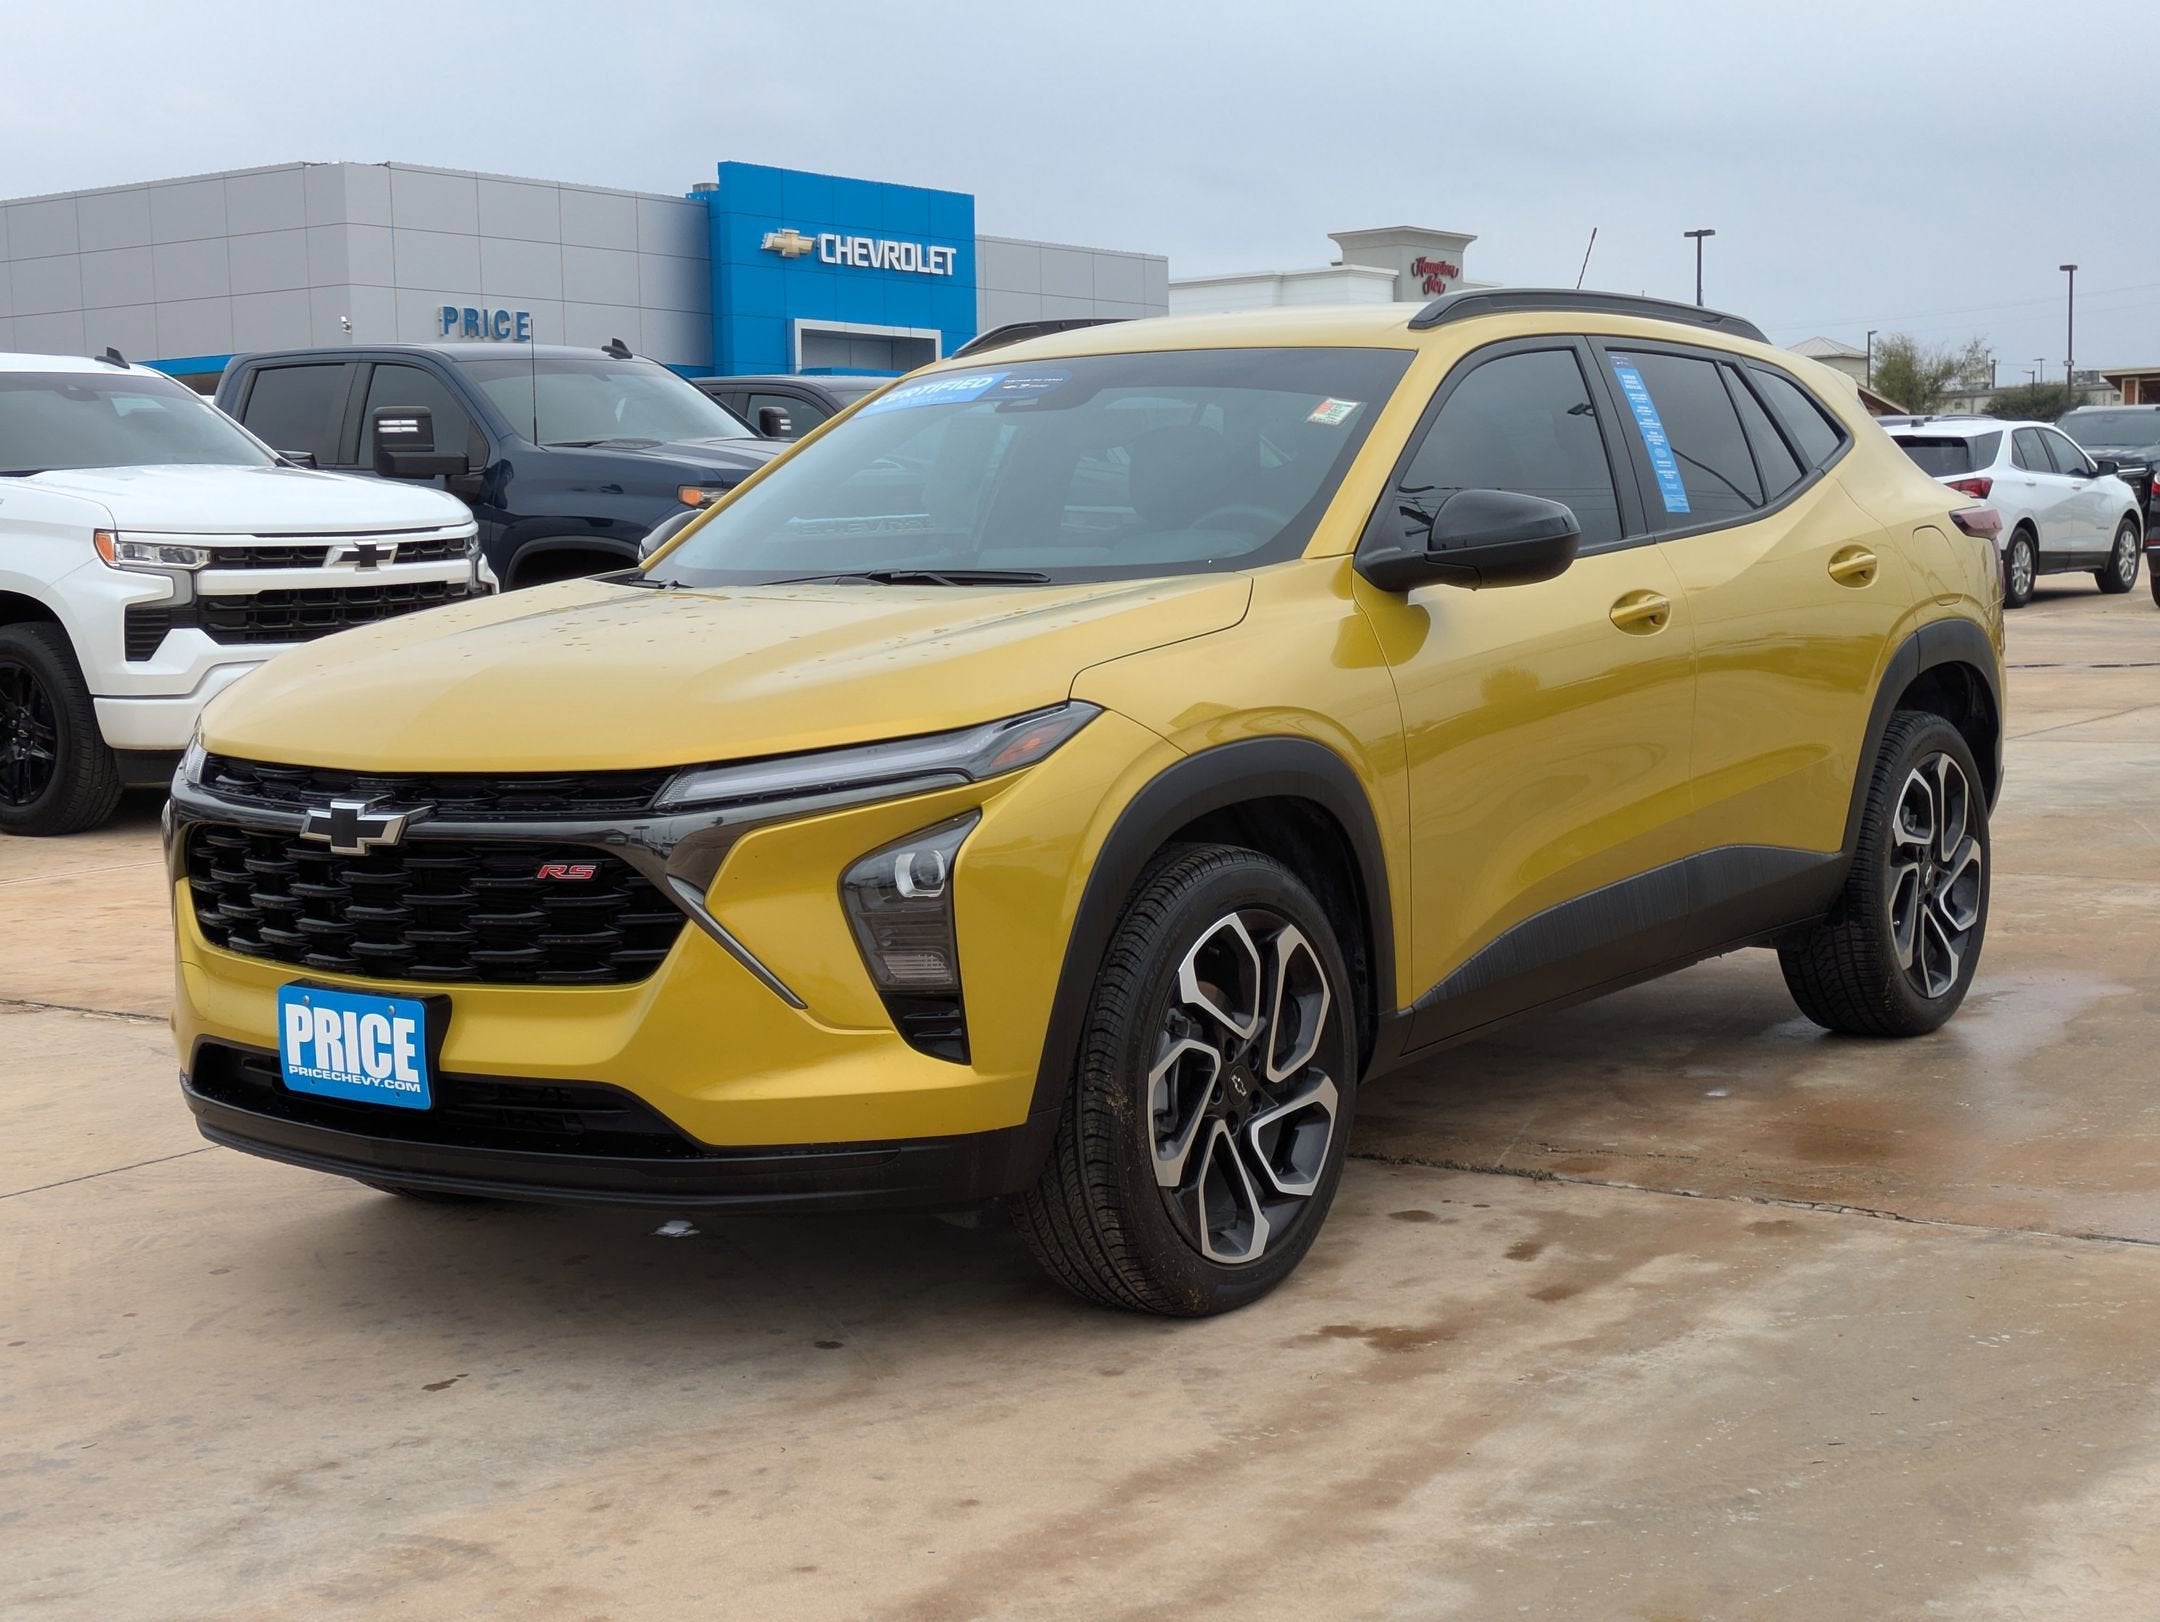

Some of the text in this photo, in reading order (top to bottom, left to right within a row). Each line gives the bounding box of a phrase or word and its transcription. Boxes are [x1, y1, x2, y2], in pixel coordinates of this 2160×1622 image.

[817, 233, 957, 276] CHEVROLET
[441, 306, 531, 341] PRICE
[537, 864, 597, 880] RS
[285, 1003, 420, 1083] PRICE
[289, 1065, 421, 1093] PRICECHEVY.COM
